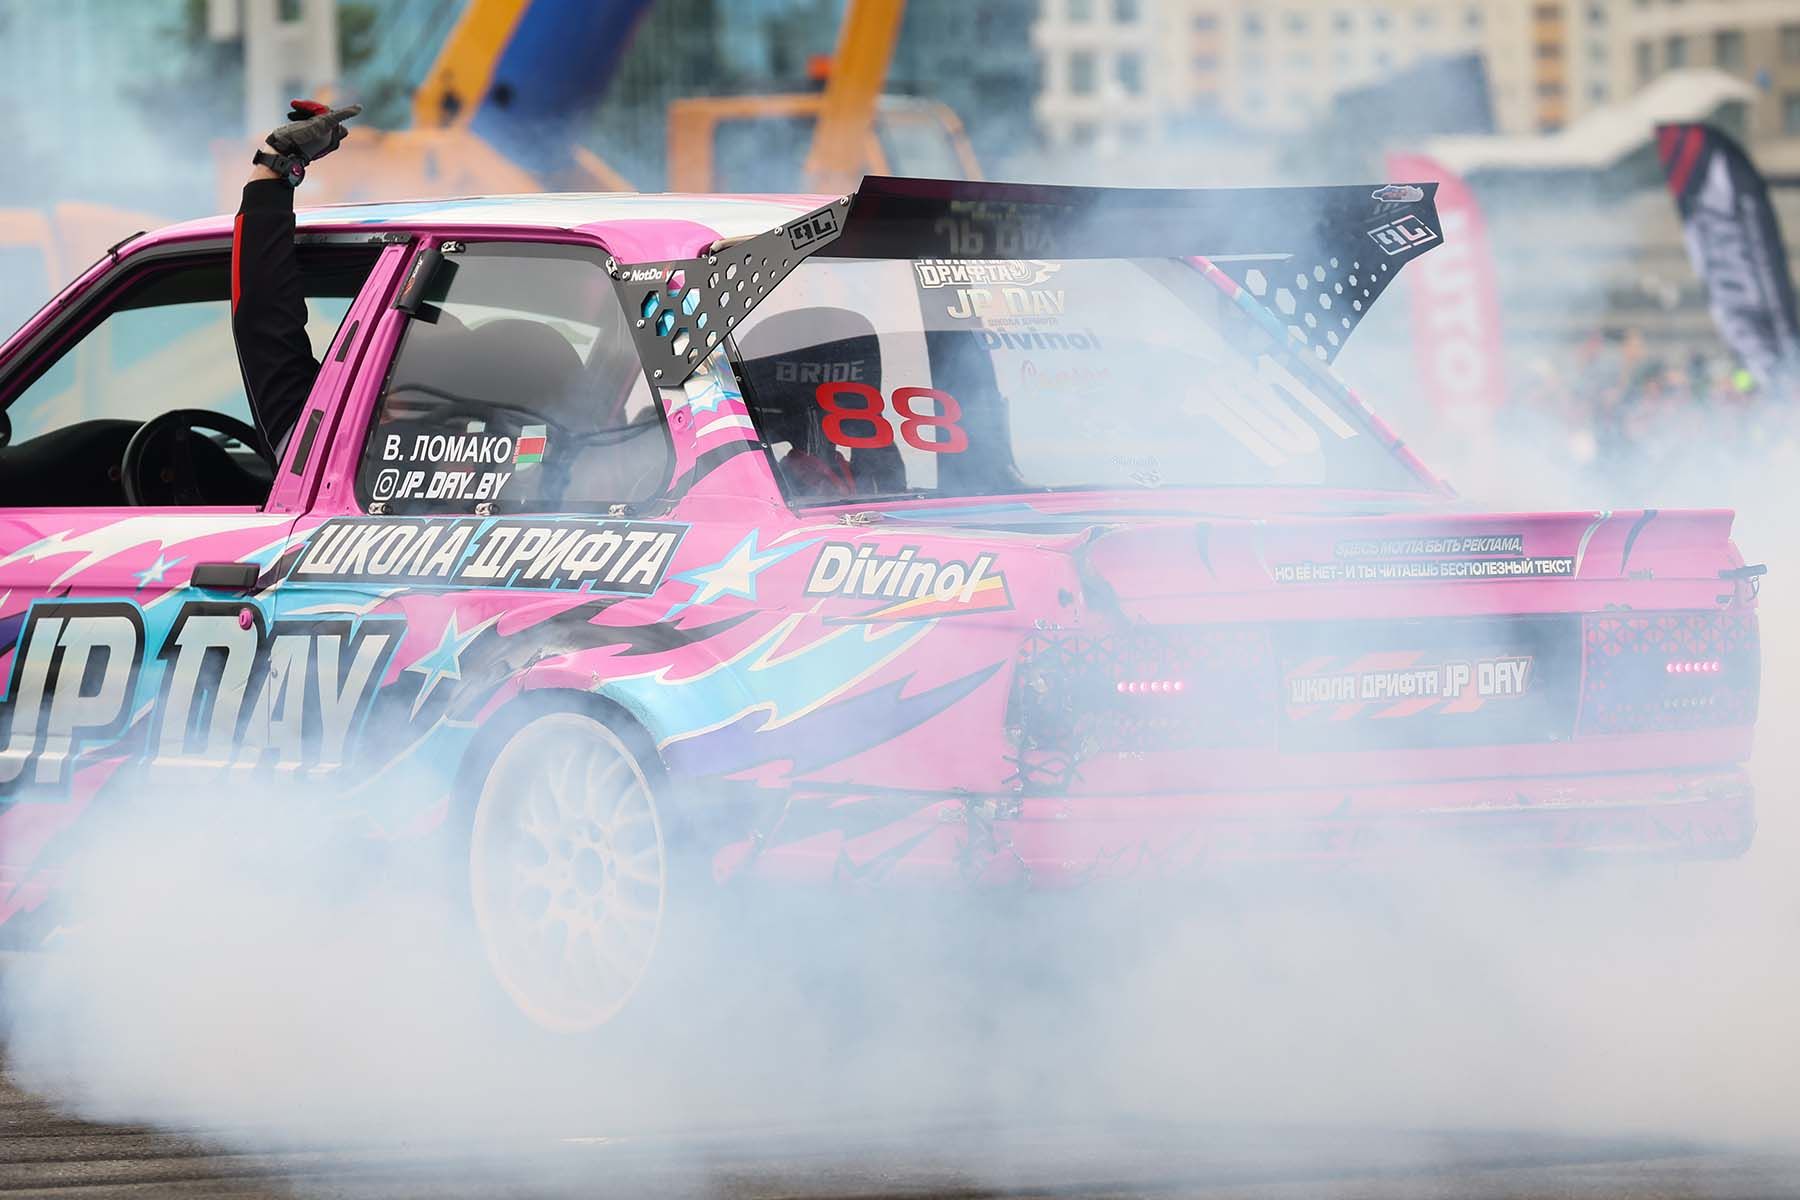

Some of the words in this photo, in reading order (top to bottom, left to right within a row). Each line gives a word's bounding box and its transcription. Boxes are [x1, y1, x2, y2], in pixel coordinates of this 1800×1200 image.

[947, 289, 992, 318] JP
[1002, 288, 1065, 315] DAY
[973, 328, 1101, 350] Divinol
[776, 360, 864, 382] BRIDE
[815, 382, 969, 453] 88
[383, 434, 403, 461] В.
[410, 435, 512, 463] ЛОМАКО
[395, 471, 511, 499] JP_DAY_BY
[297, 524, 473, 577] ШКОЛА
[460, 527, 678, 585] ДРИФТА
[1426, 538, 1460, 553] БЫТЬ
[1462, 536, 1522, 553] РЕКЛАМА,
[807, 541, 990, 603] Divinol
[1275, 566, 1295, 580] НО
[1346, 564, 1356, 578] И
[1358, 564, 1377, 578] ТЫ
[1378, 562, 1438, 577] ЧИТАЕШЬ
[1440, 557, 1533, 576] БЕСПОЛЕЗНЫЙ
[1535, 559, 1573, 574] ТЕКСТ
[1291, 677, 1355, 703] ШКОЛА
[1362, 670, 1441, 699] ДРИФТА
[1443, 664, 1470, 697] JP
[1478, 661, 1527, 695] DAY
[0, 616, 136, 784] JP
[151, 616, 391, 776] DAY
